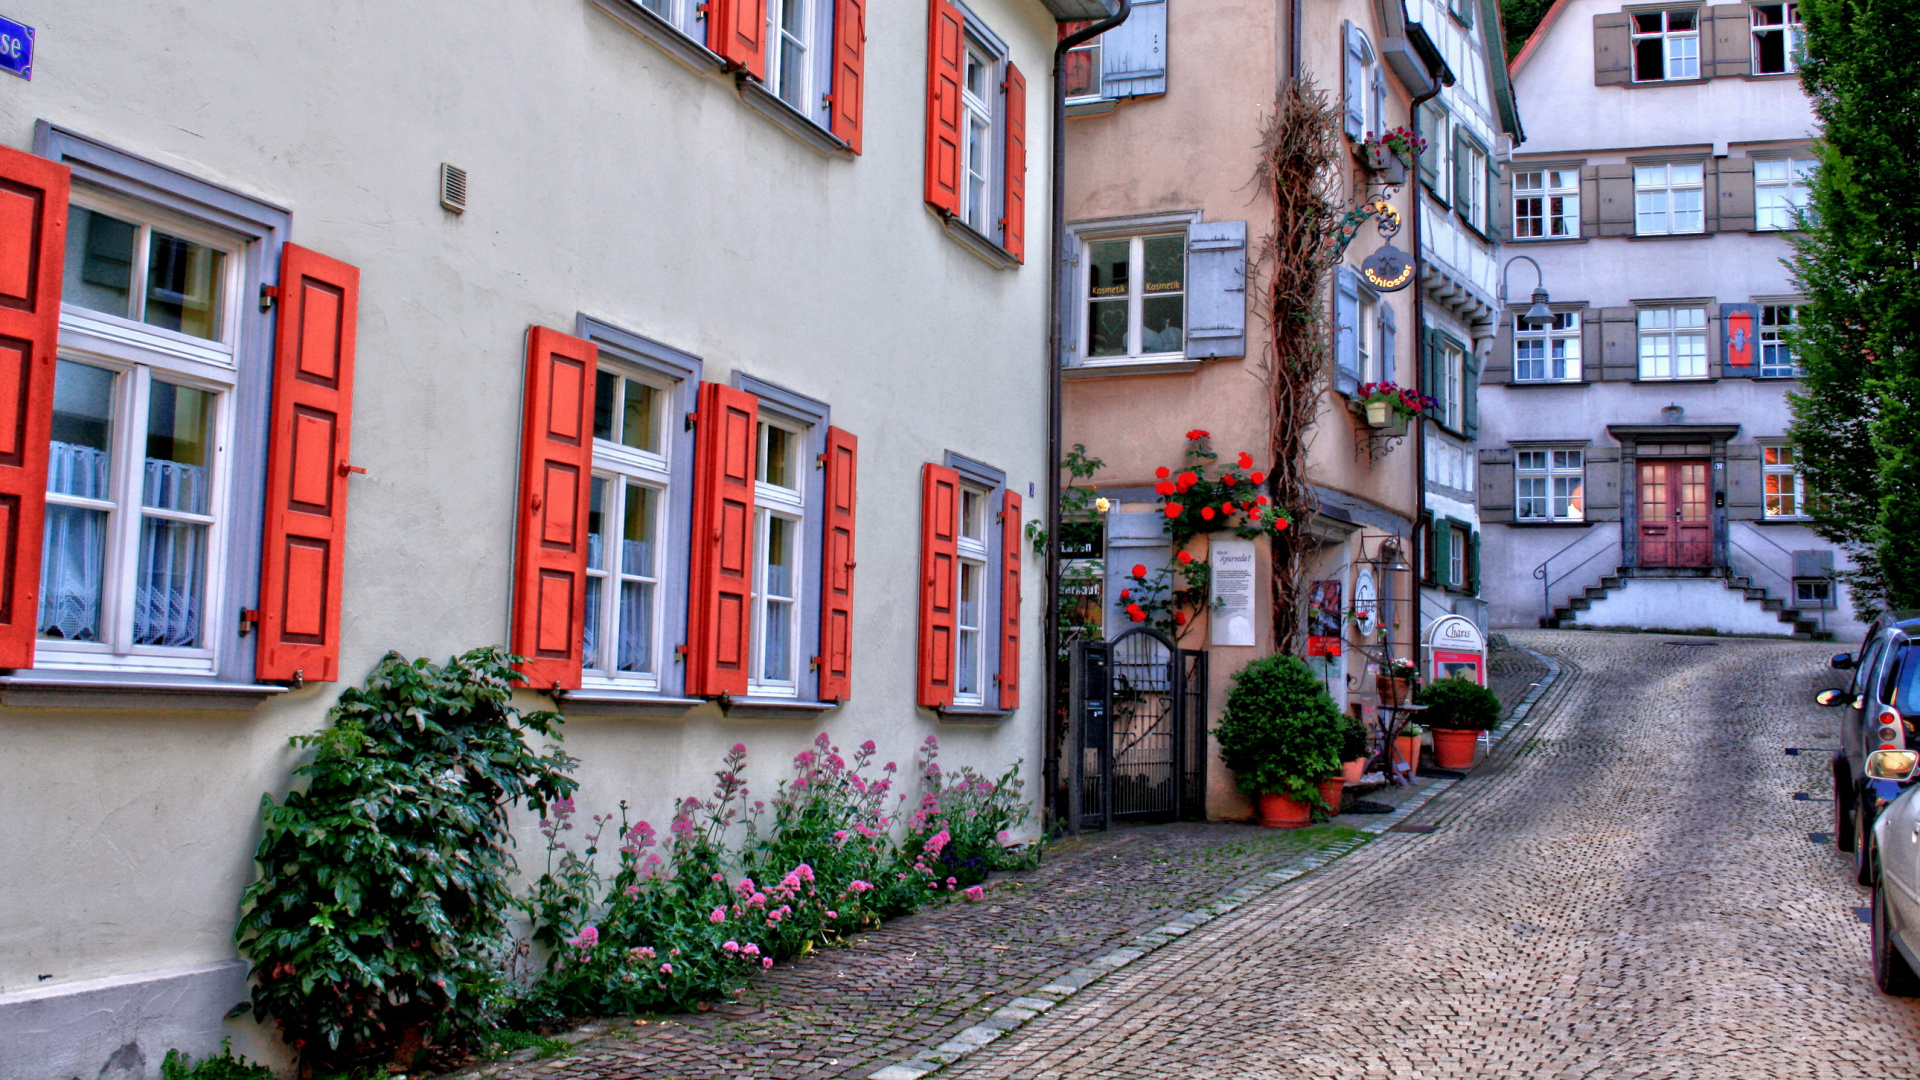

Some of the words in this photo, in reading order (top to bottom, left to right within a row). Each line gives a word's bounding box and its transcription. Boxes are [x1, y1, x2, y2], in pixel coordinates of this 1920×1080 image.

[1365, 264, 1412, 288] Schlosser
[1092, 285, 1125, 294] Kosmetik
[1146, 281, 1180, 290] Kosmetik
[1220, 554, 1251, 564] Ayurveda?
[1445, 622, 1471, 638] Charis
